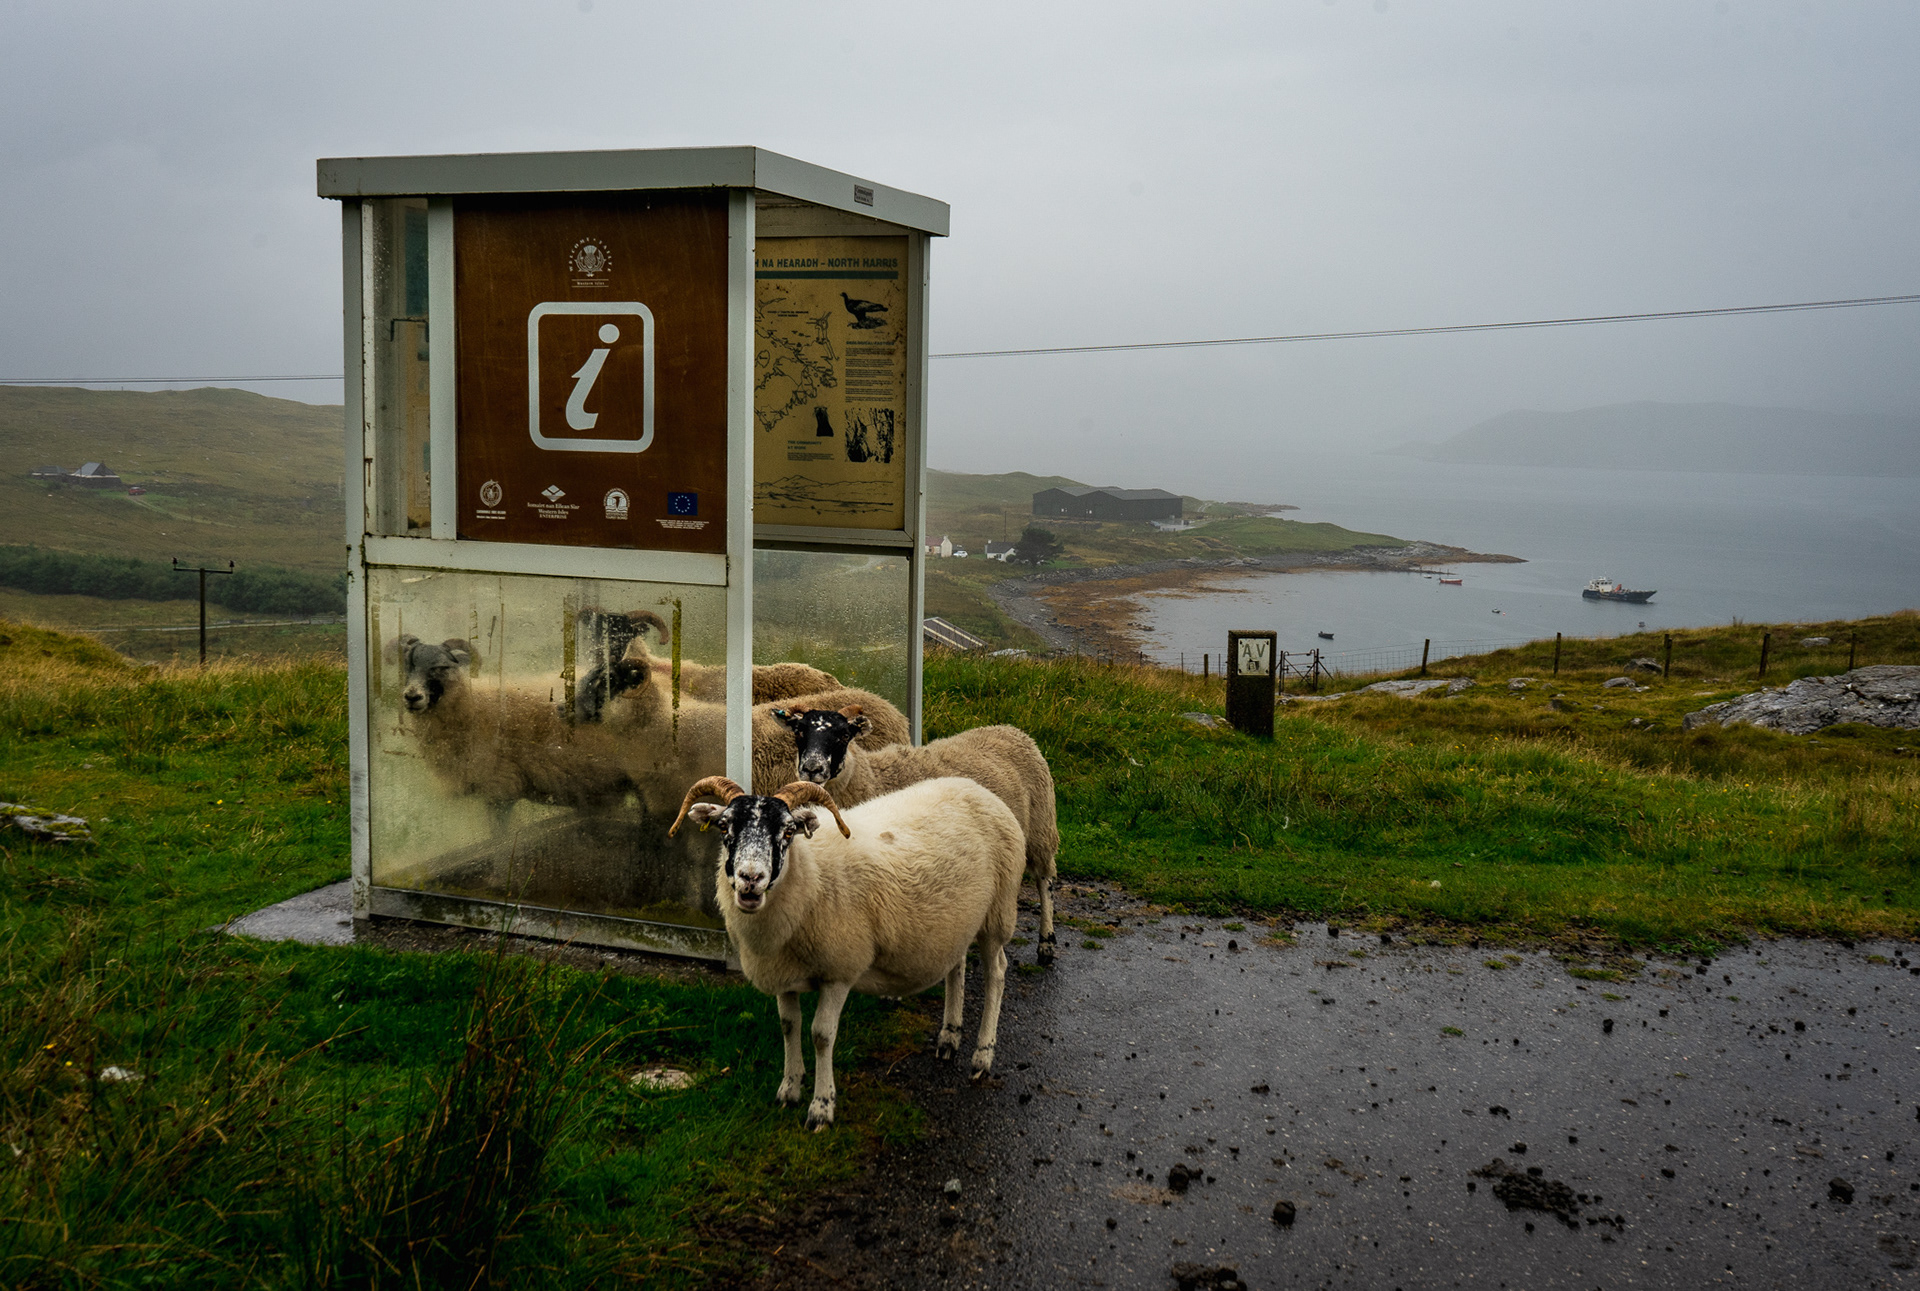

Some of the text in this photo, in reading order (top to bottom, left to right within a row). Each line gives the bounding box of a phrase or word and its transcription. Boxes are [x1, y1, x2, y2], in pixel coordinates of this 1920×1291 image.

[762, 258, 774, 268] NA
[777, 258, 819, 268] HEARADH
[827, 258, 860, 268] NORTH
[862, 258, 898, 268] HARRIS
[565, 323, 621, 431] i
